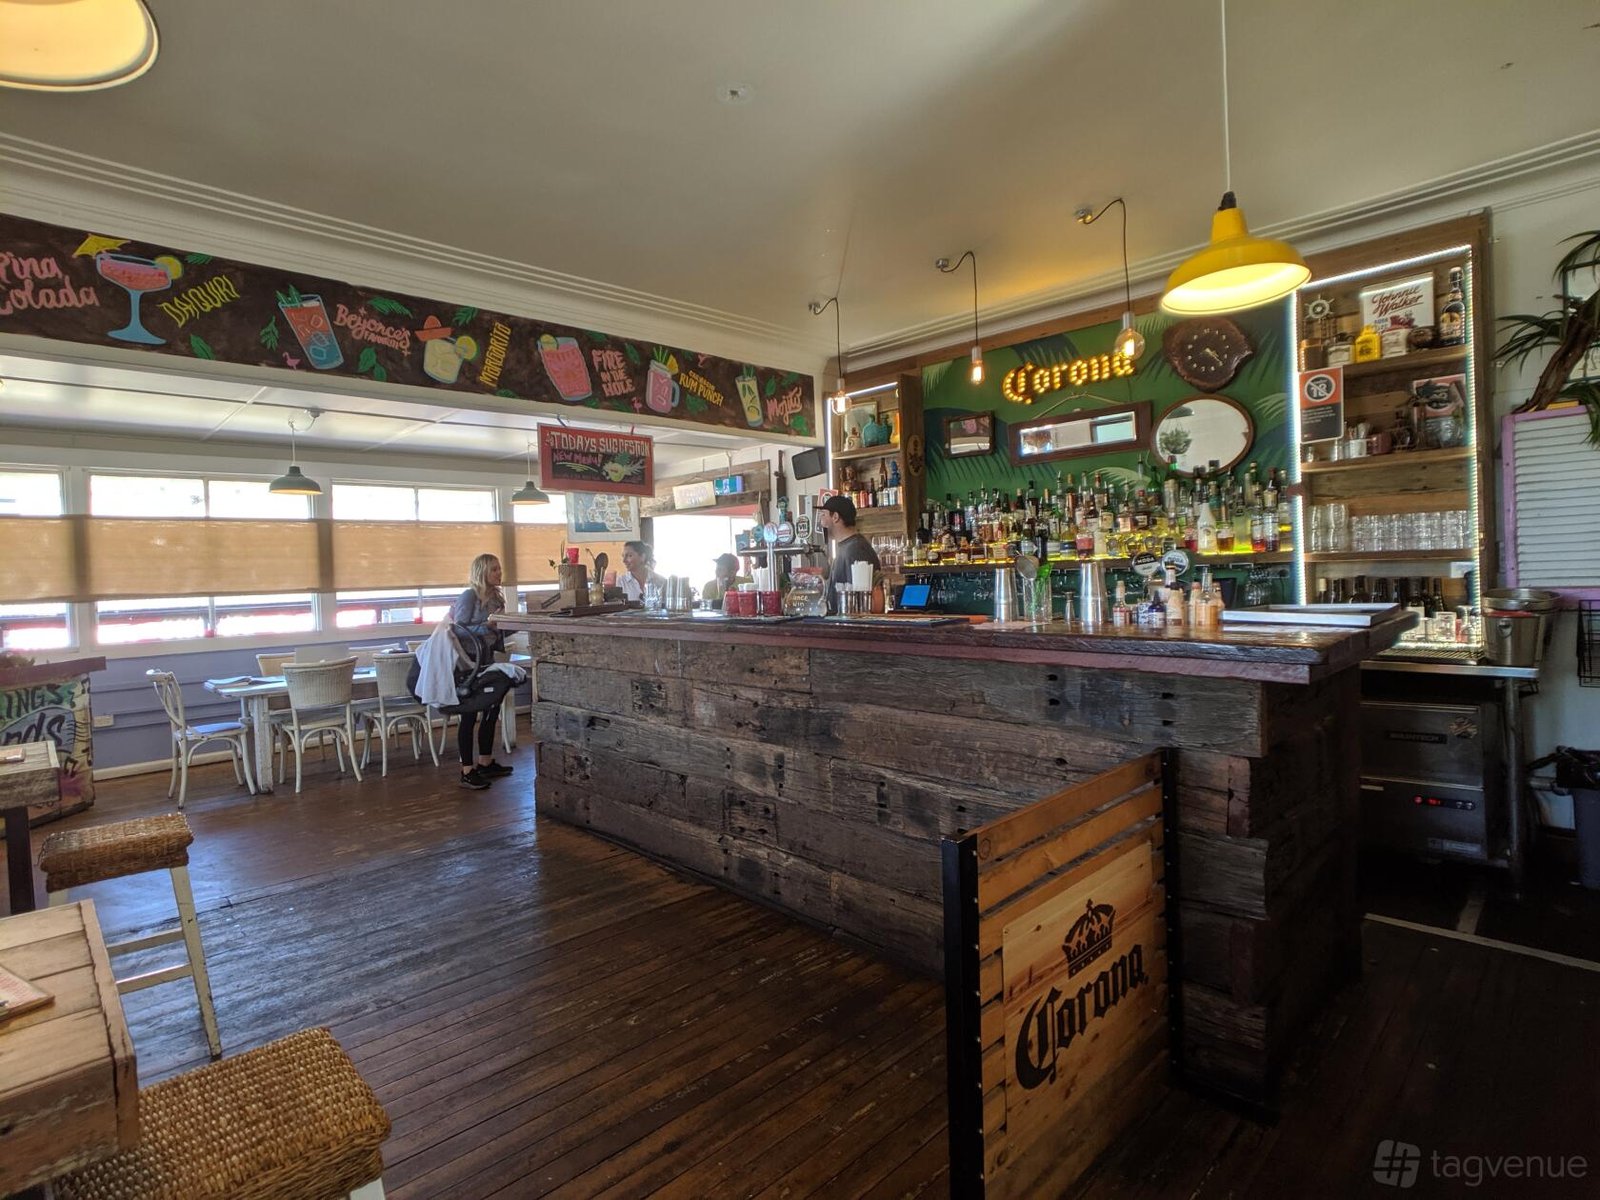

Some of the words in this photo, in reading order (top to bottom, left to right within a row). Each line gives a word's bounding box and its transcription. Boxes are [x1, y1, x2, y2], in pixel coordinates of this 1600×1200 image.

[155, 274, 240, 328] DAIQUIRI
[1371, 284, 1421, 313] Johnnie
[1375, 294, 1424, 317] Walker
[591, 349, 626, 372] FIRE
[601, 379, 636, 397] HOLE
[679, 373, 698, 392] RUM
[697, 384, 724, 407] PUNCH
[1002, 353, 1136, 405] Corona
[766, 386, 803, 425] Mojito
[550, 431, 597, 453] TODAYS
[599, 437, 651, 457] SUGGESTION
[1015, 944, 1148, 1090] Corona
